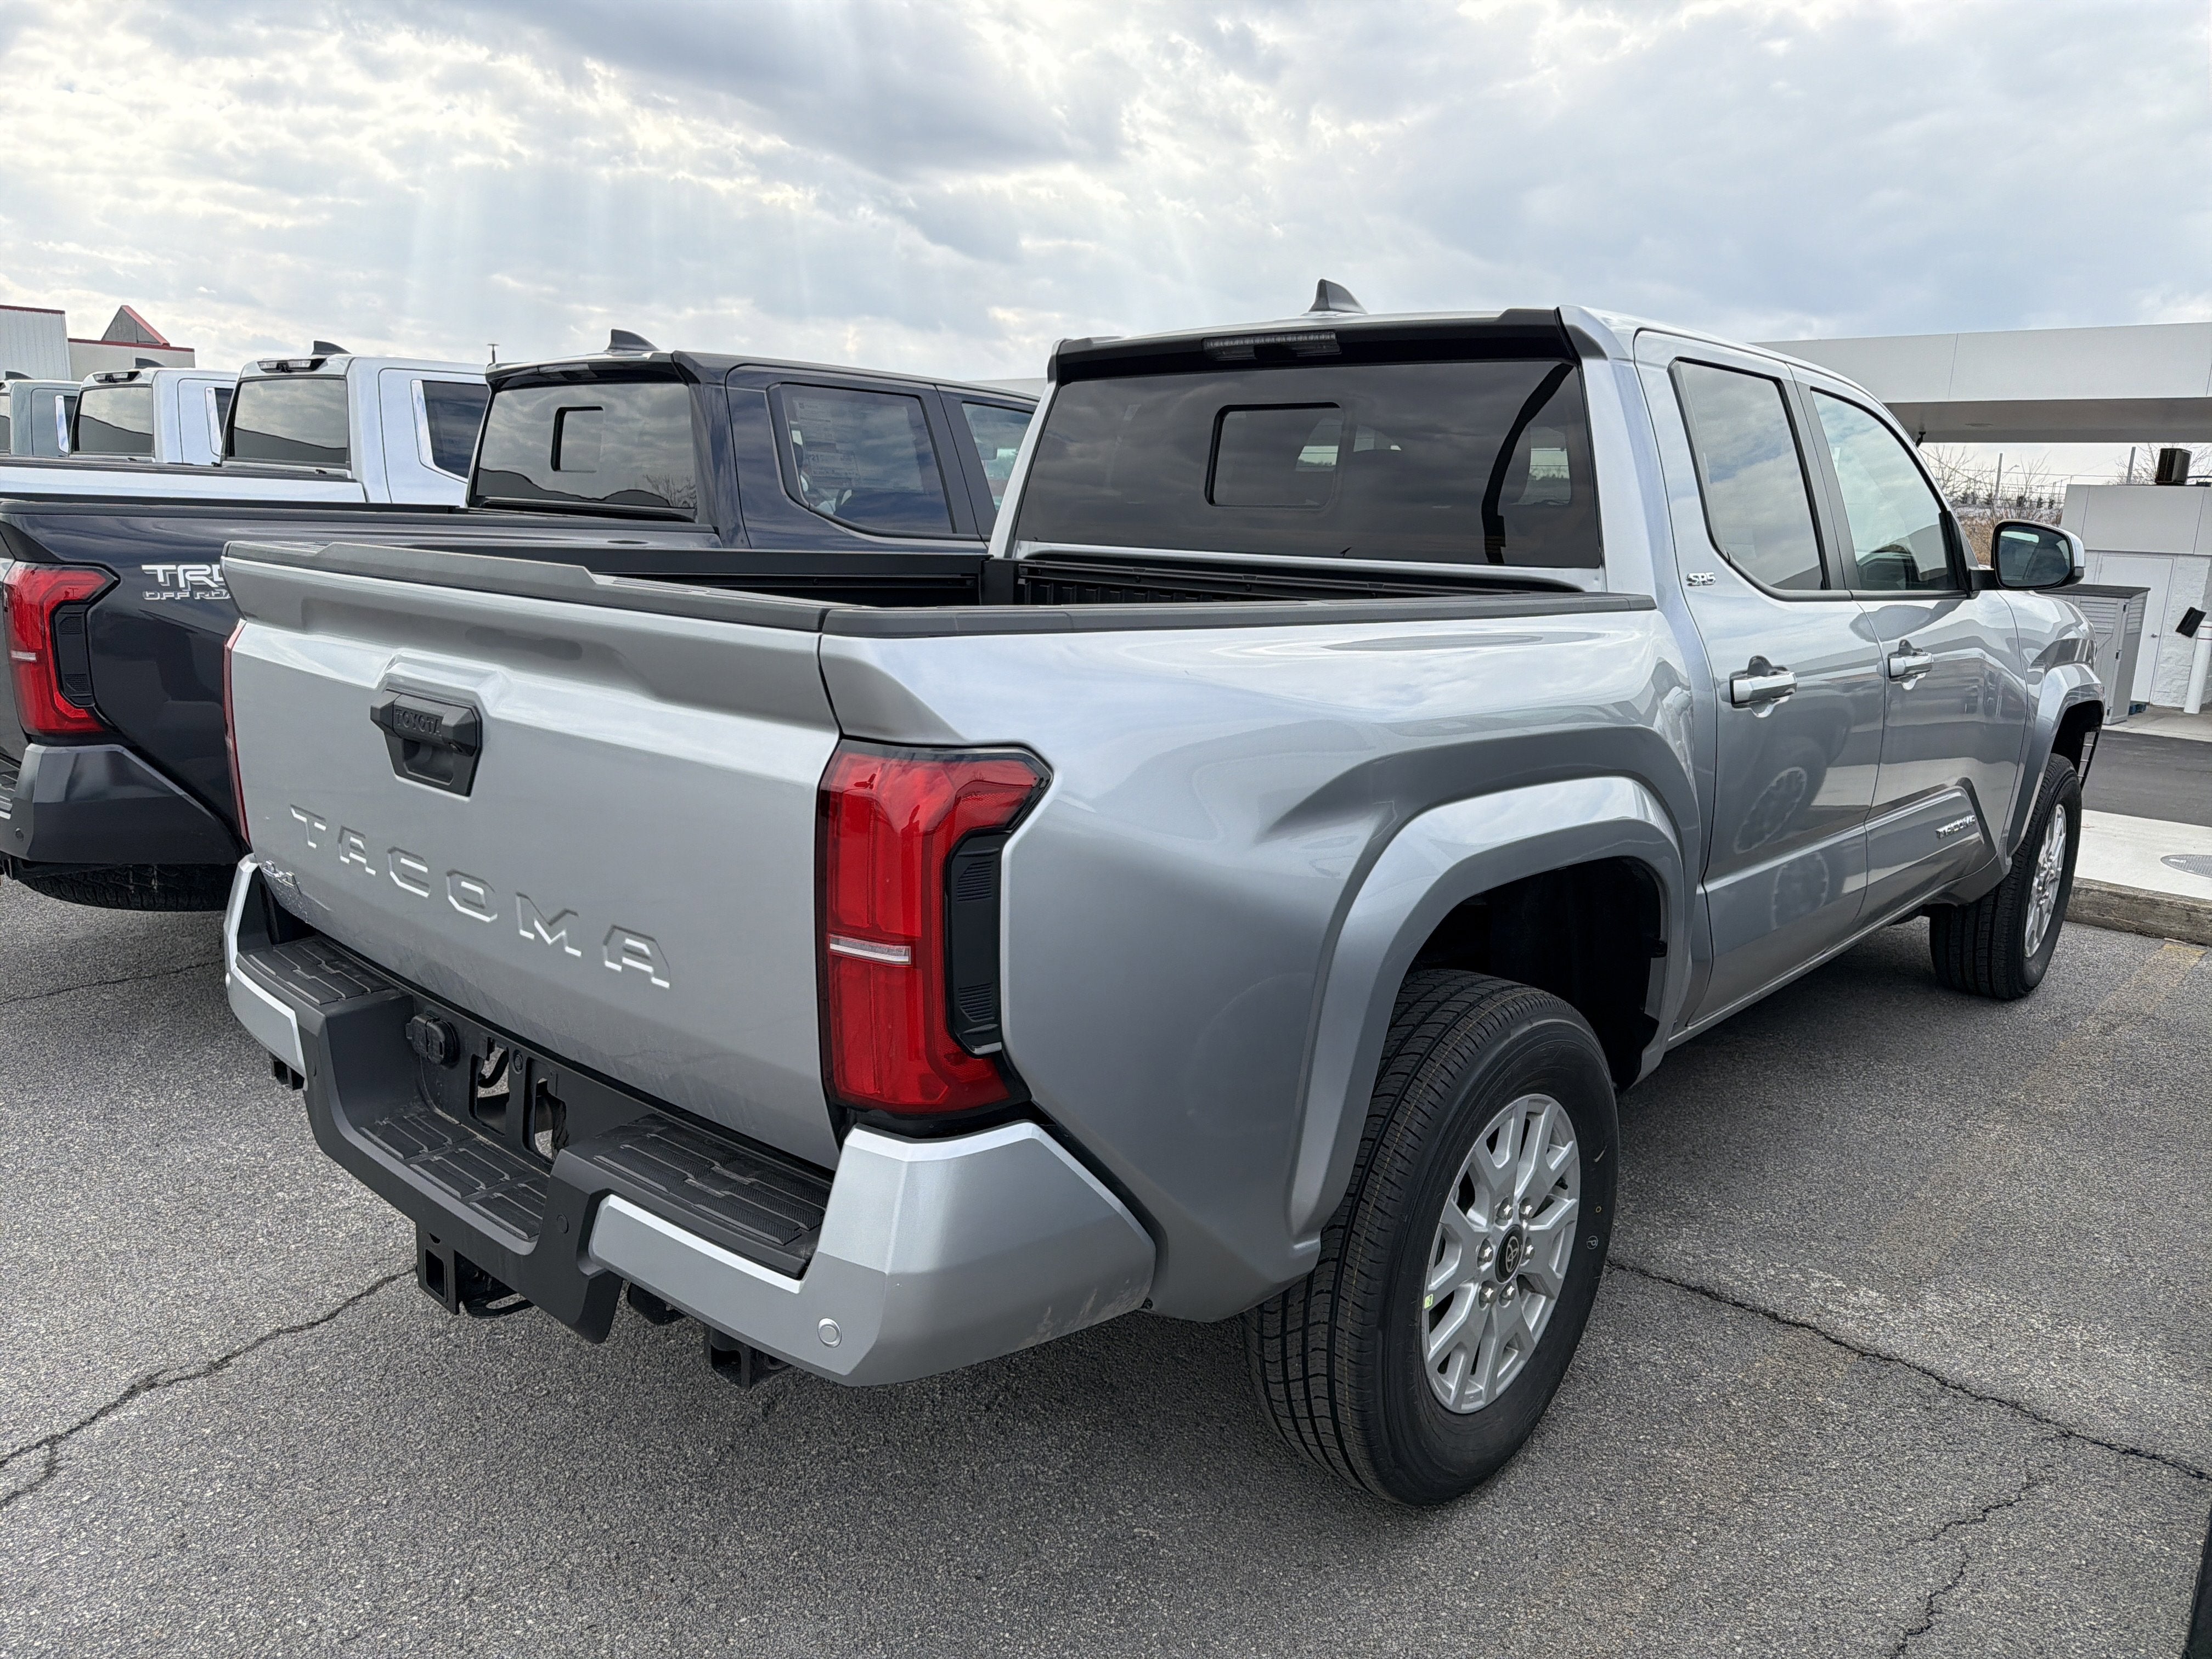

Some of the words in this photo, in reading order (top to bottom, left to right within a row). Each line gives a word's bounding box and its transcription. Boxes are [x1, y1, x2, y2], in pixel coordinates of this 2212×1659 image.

[1686, 572, 1716, 586] SR5
[142, 590, 190, 600] OFF
[290, 804, 670, 988] TACOMA
